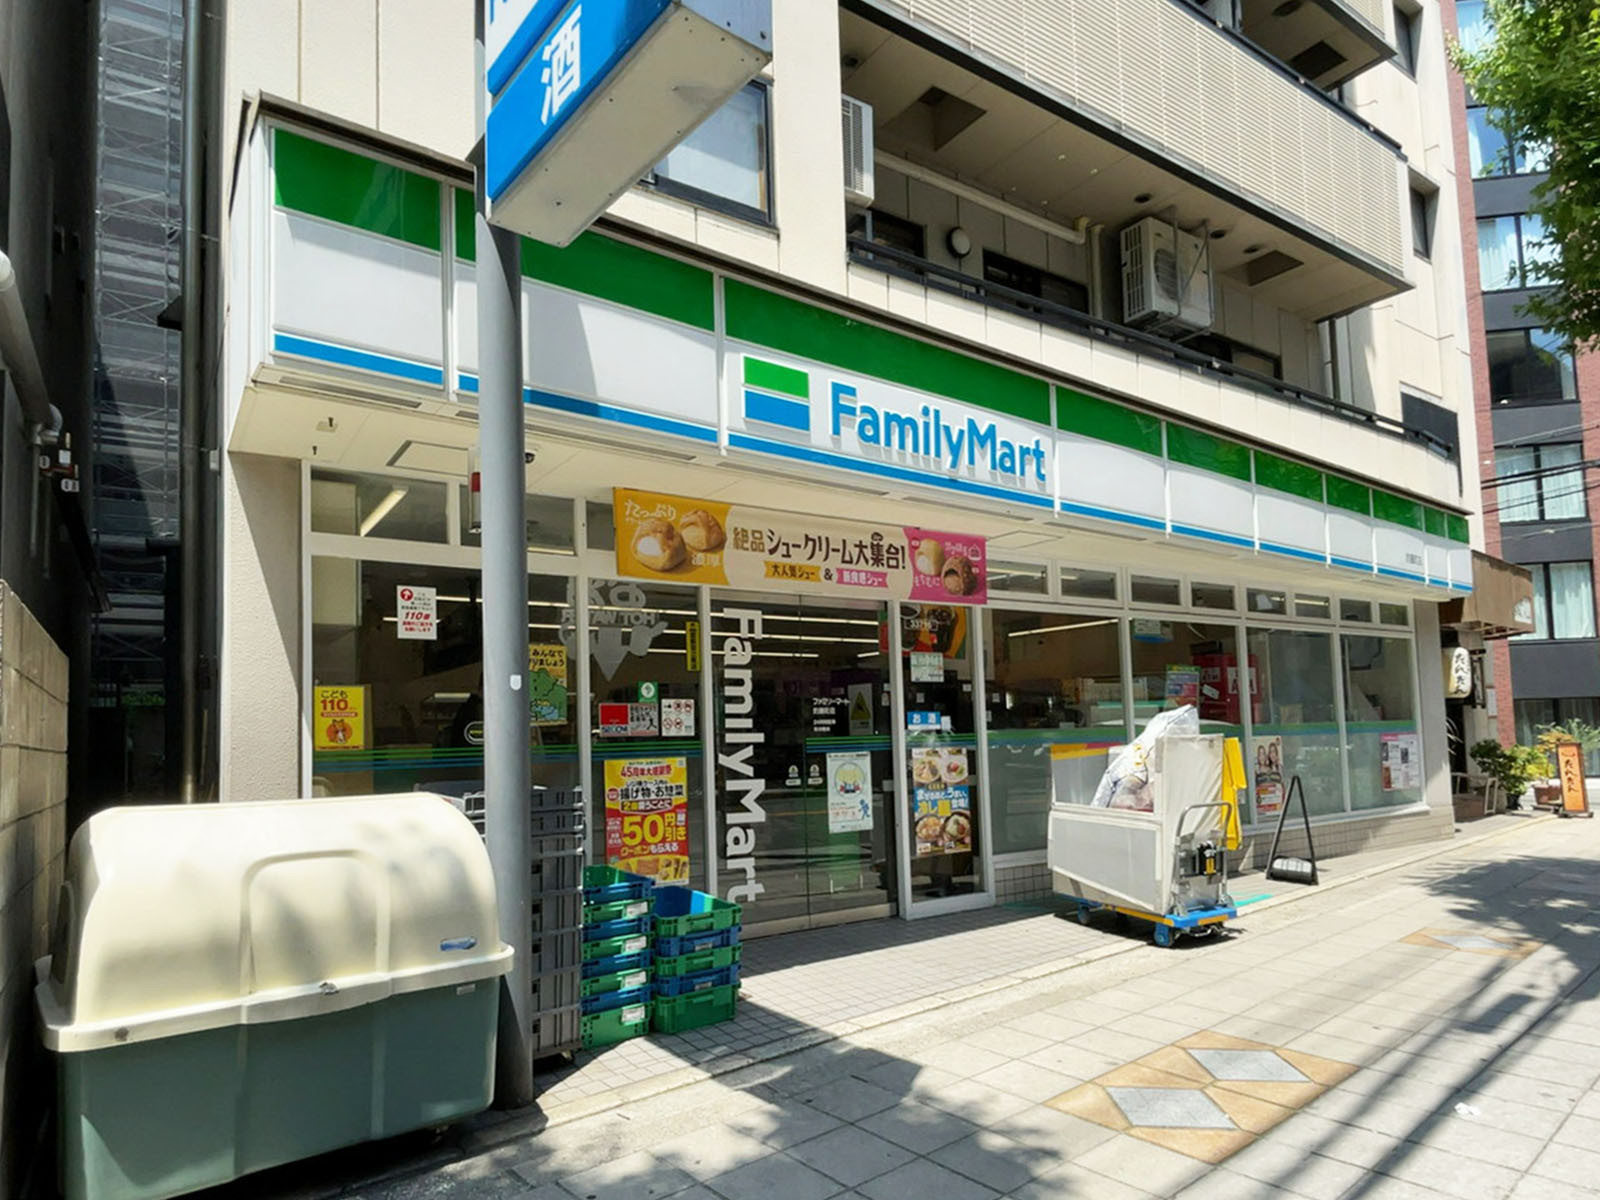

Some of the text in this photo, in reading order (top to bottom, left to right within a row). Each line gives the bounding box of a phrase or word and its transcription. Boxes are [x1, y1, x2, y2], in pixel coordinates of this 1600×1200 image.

[541, 3, 582, 125] 酒
[831, 381, 1047, 482] FamilyMart
[718, 607, 767, 903] FamilyMart
